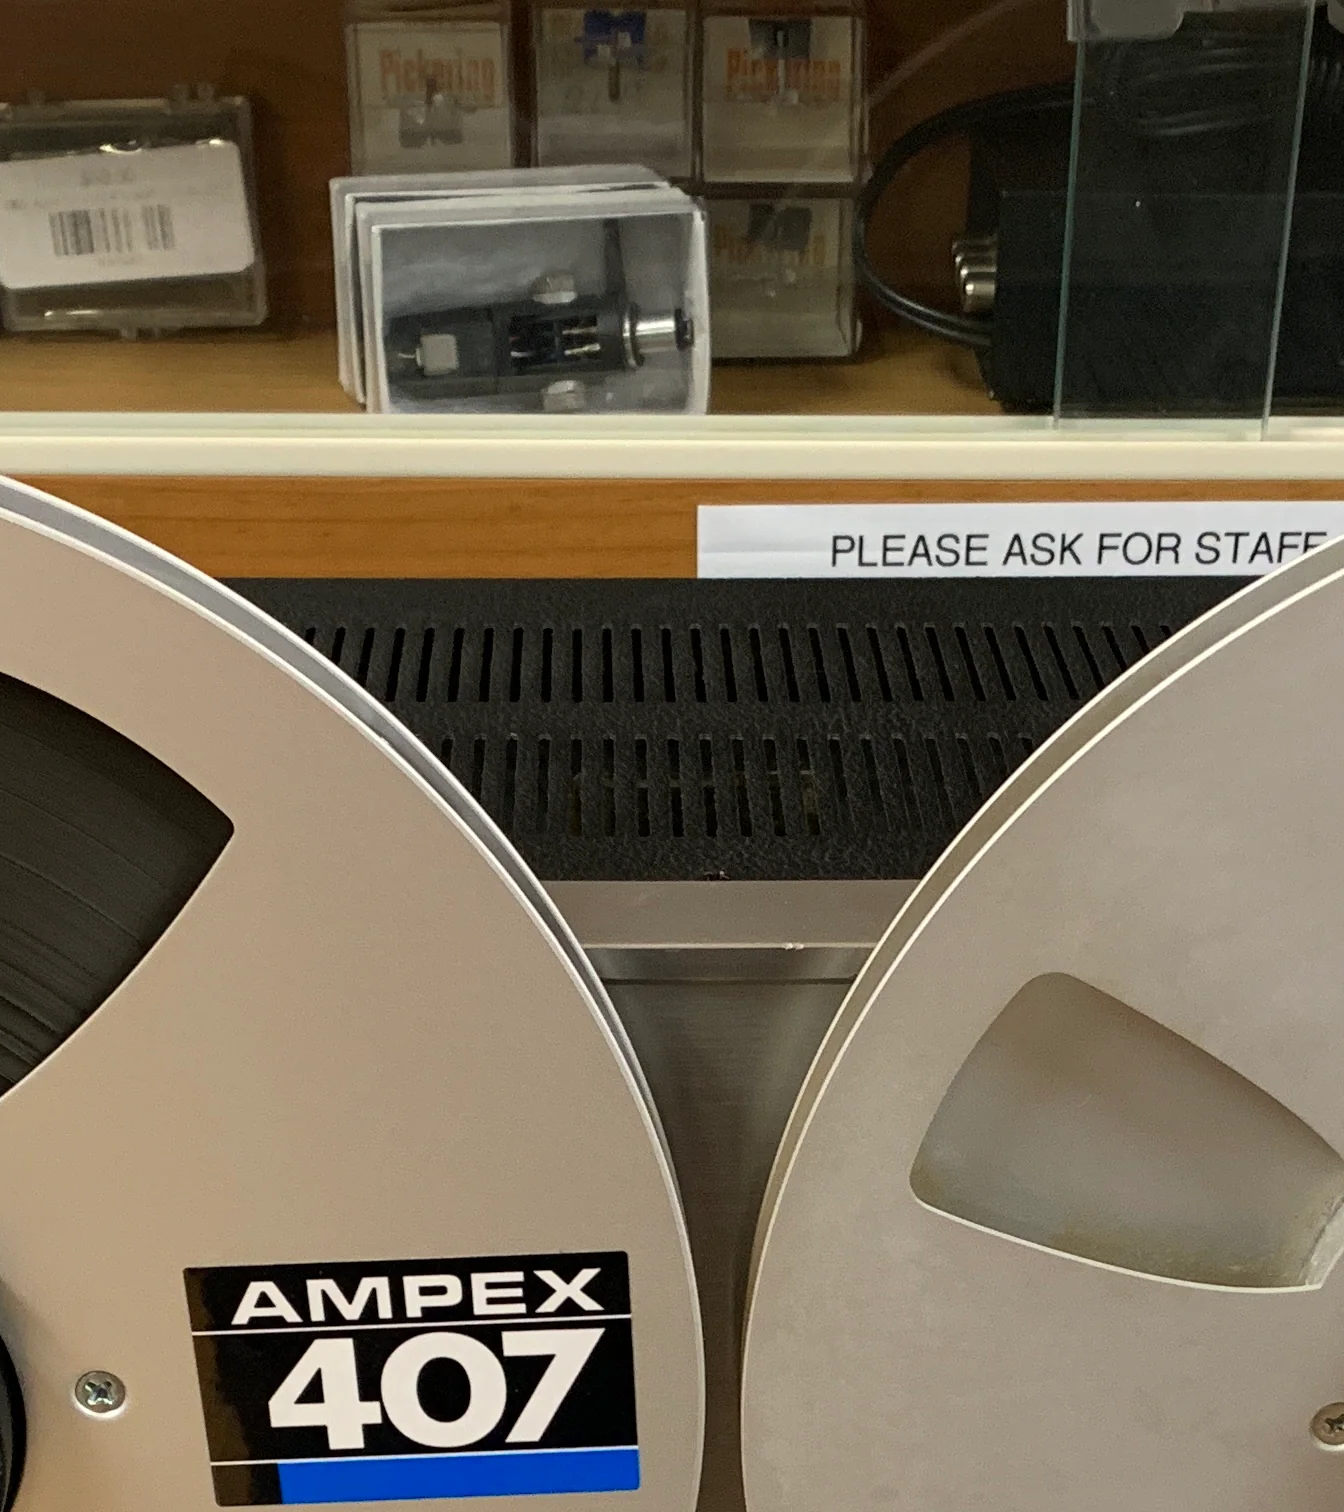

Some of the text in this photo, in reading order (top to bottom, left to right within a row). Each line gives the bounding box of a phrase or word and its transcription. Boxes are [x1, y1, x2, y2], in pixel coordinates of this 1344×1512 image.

[830, 530, 1328, 569] PLEASE ASK FOR STAFF
[231, 1267, 605, 1326] AMPEX
[267, 1327, 606, 1451] 407
